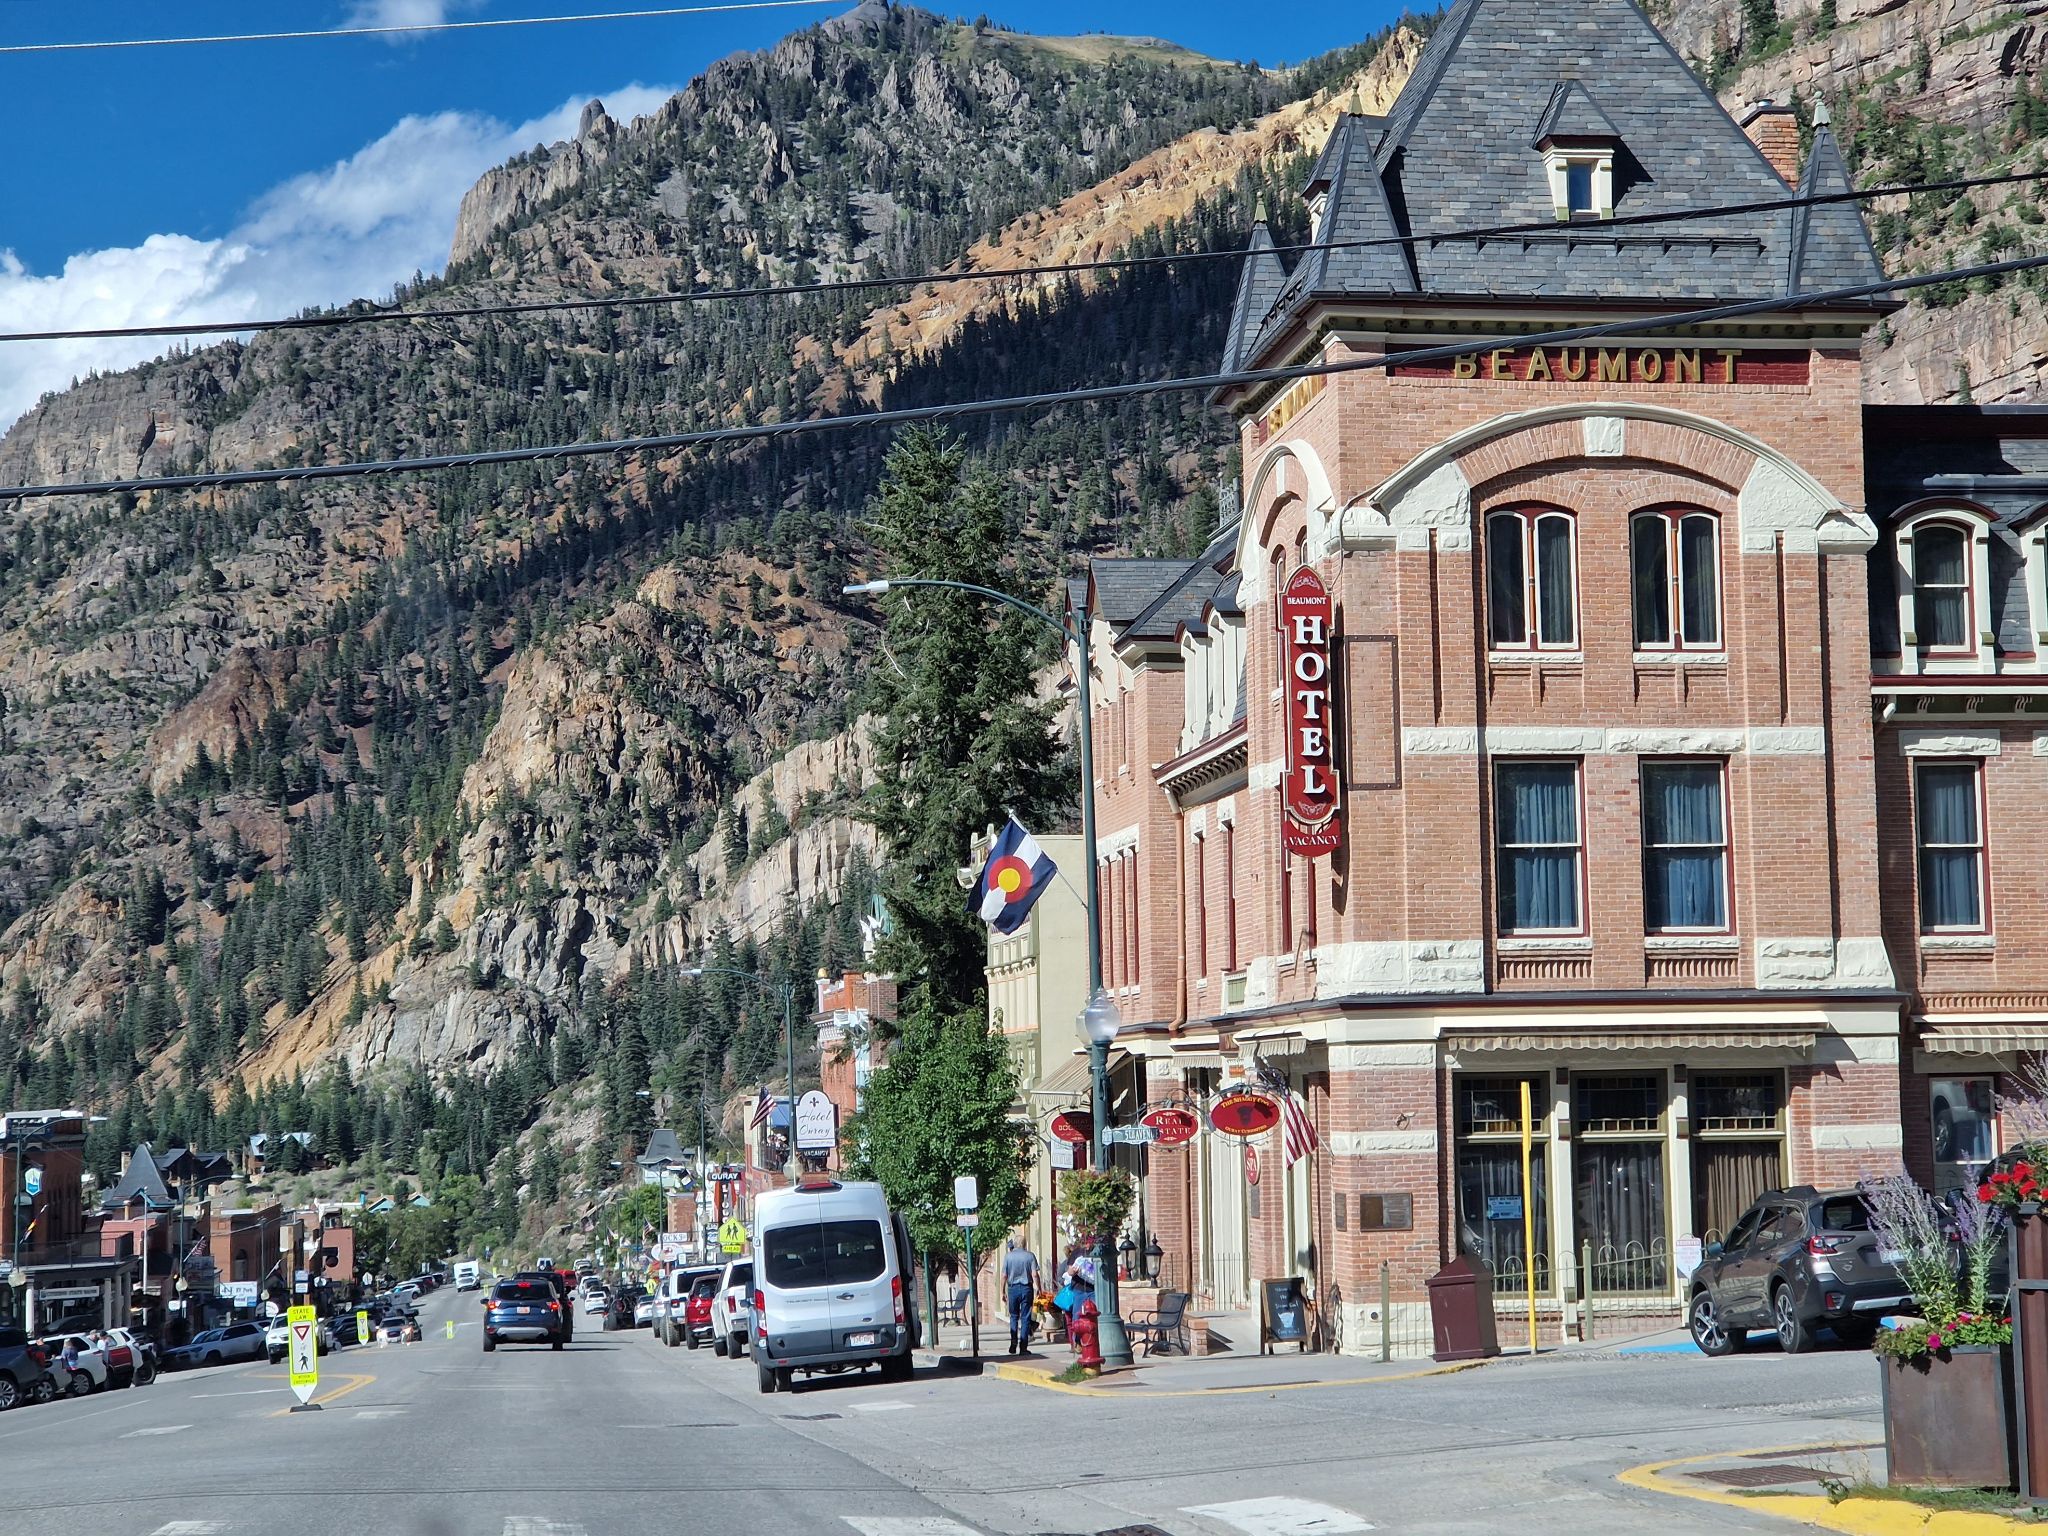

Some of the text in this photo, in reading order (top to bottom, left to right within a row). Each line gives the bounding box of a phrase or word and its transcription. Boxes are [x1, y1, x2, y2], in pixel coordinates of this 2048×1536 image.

[1454, 346, 1742, 383] BEAUMONT
[1287, 597, 1326, 605] BEAUMONT
[1292, 615, 1326, 794] HOTEL
[1289, 835, 1339, 846] VACANCY
[799, 1110, 831, 1123] Hotel
[800, 1124, 830, 1137] Ouray
[1159, 1127, 1191, 1135] STATE
[803, 1150, 829, 1158] VACANCY
[1246, 1157, 1257, 1171] SPA
[711, 1172, 738, 1180] OURAY
